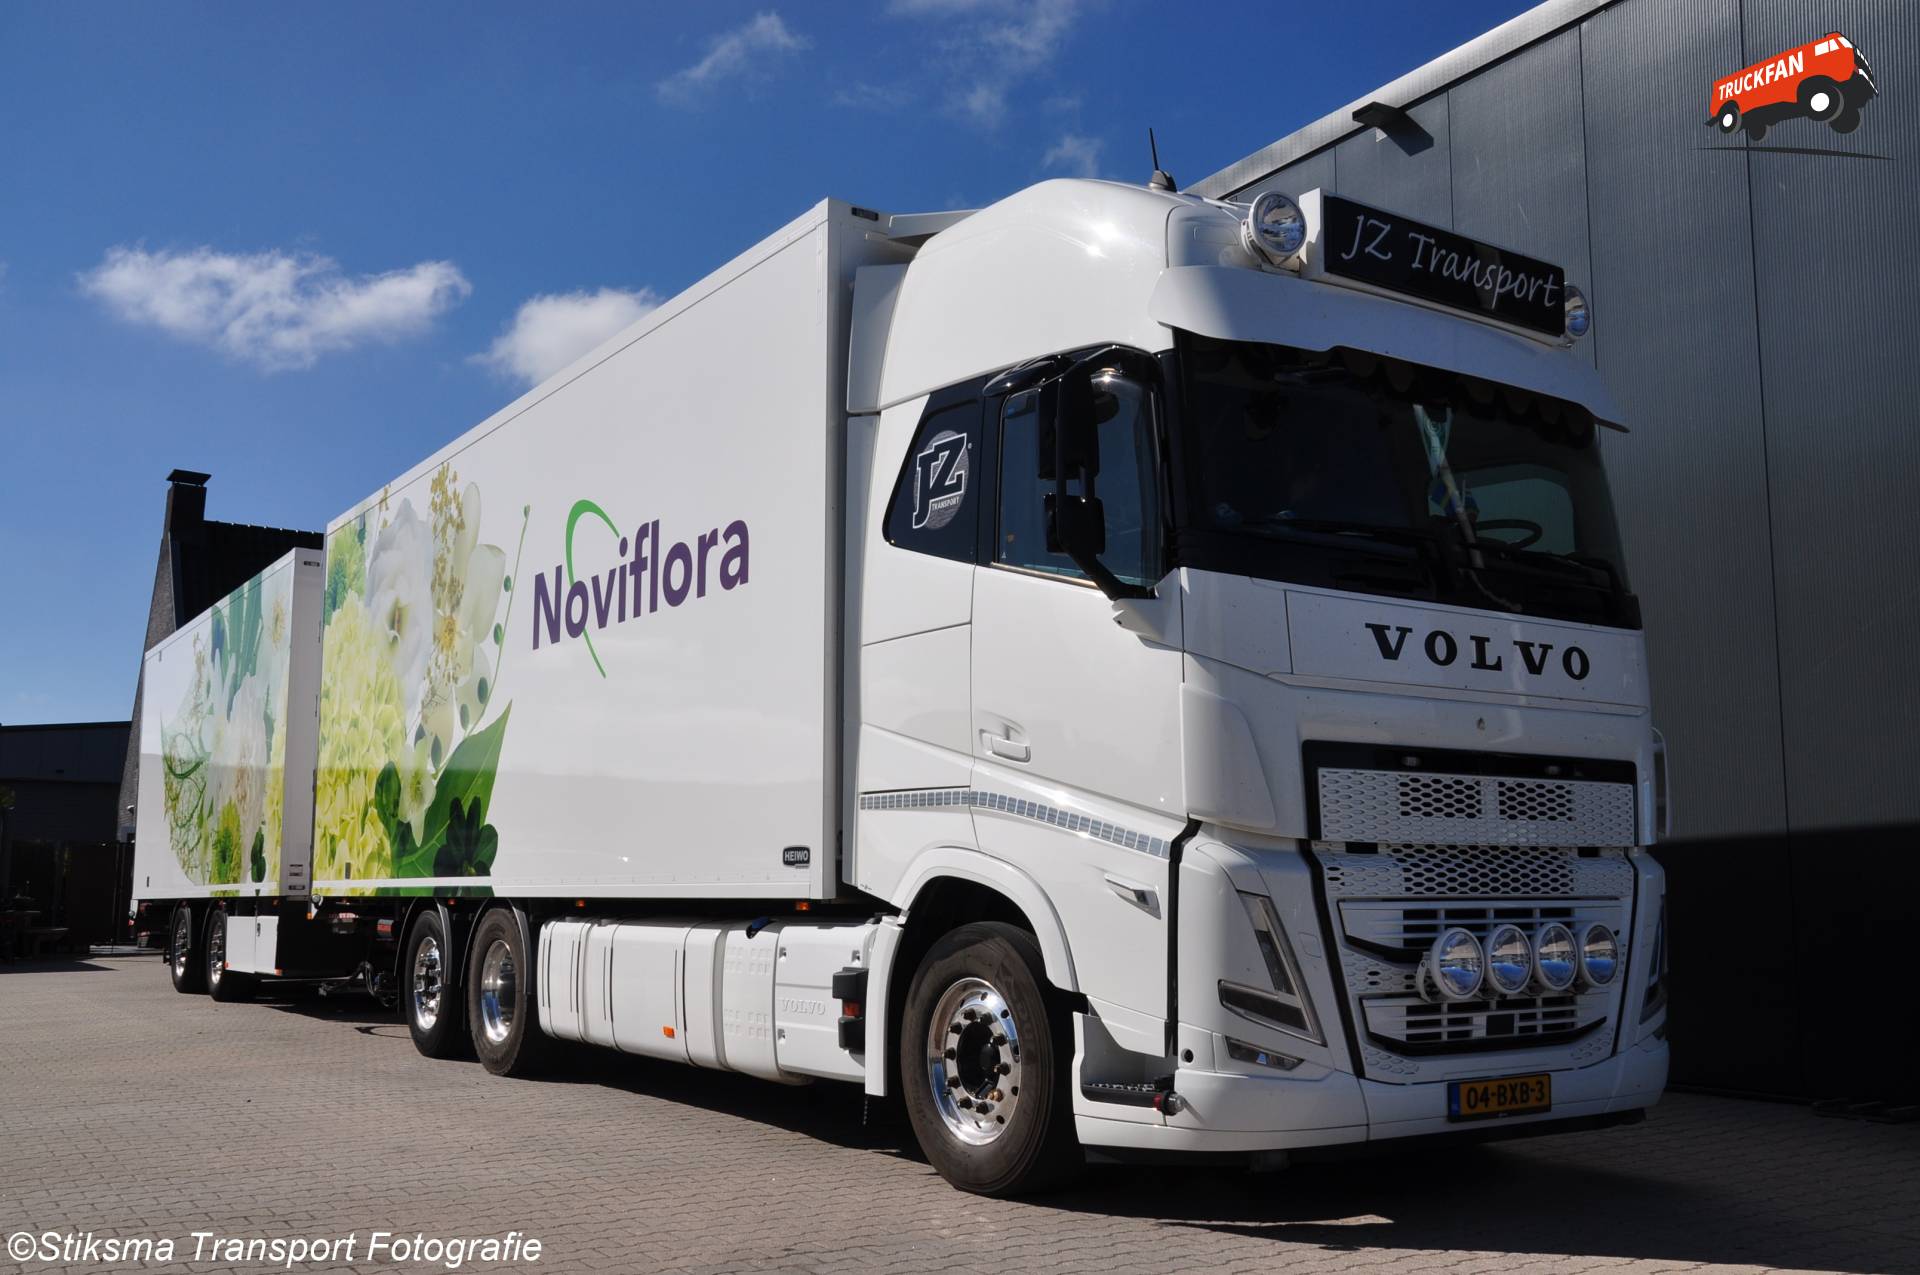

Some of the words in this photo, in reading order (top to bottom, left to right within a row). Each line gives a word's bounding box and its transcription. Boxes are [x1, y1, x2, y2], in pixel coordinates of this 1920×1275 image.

[1341, 215, 1393, 260] JZ
[1409, 232, 1560, 309] Transport
[913, 433, 967, 529] JZ
[931, 496, 960, 511] TRANSPORT
[532, 519, 749, 650] Noviflora
[1365, 622, 1590, 680] VOLVO
[784, 850, 809, 861] HEIWO
[783, 999, 826, 1016] VOLVO
[1467, 1081, 1545, 1109] 04-BXB-3
